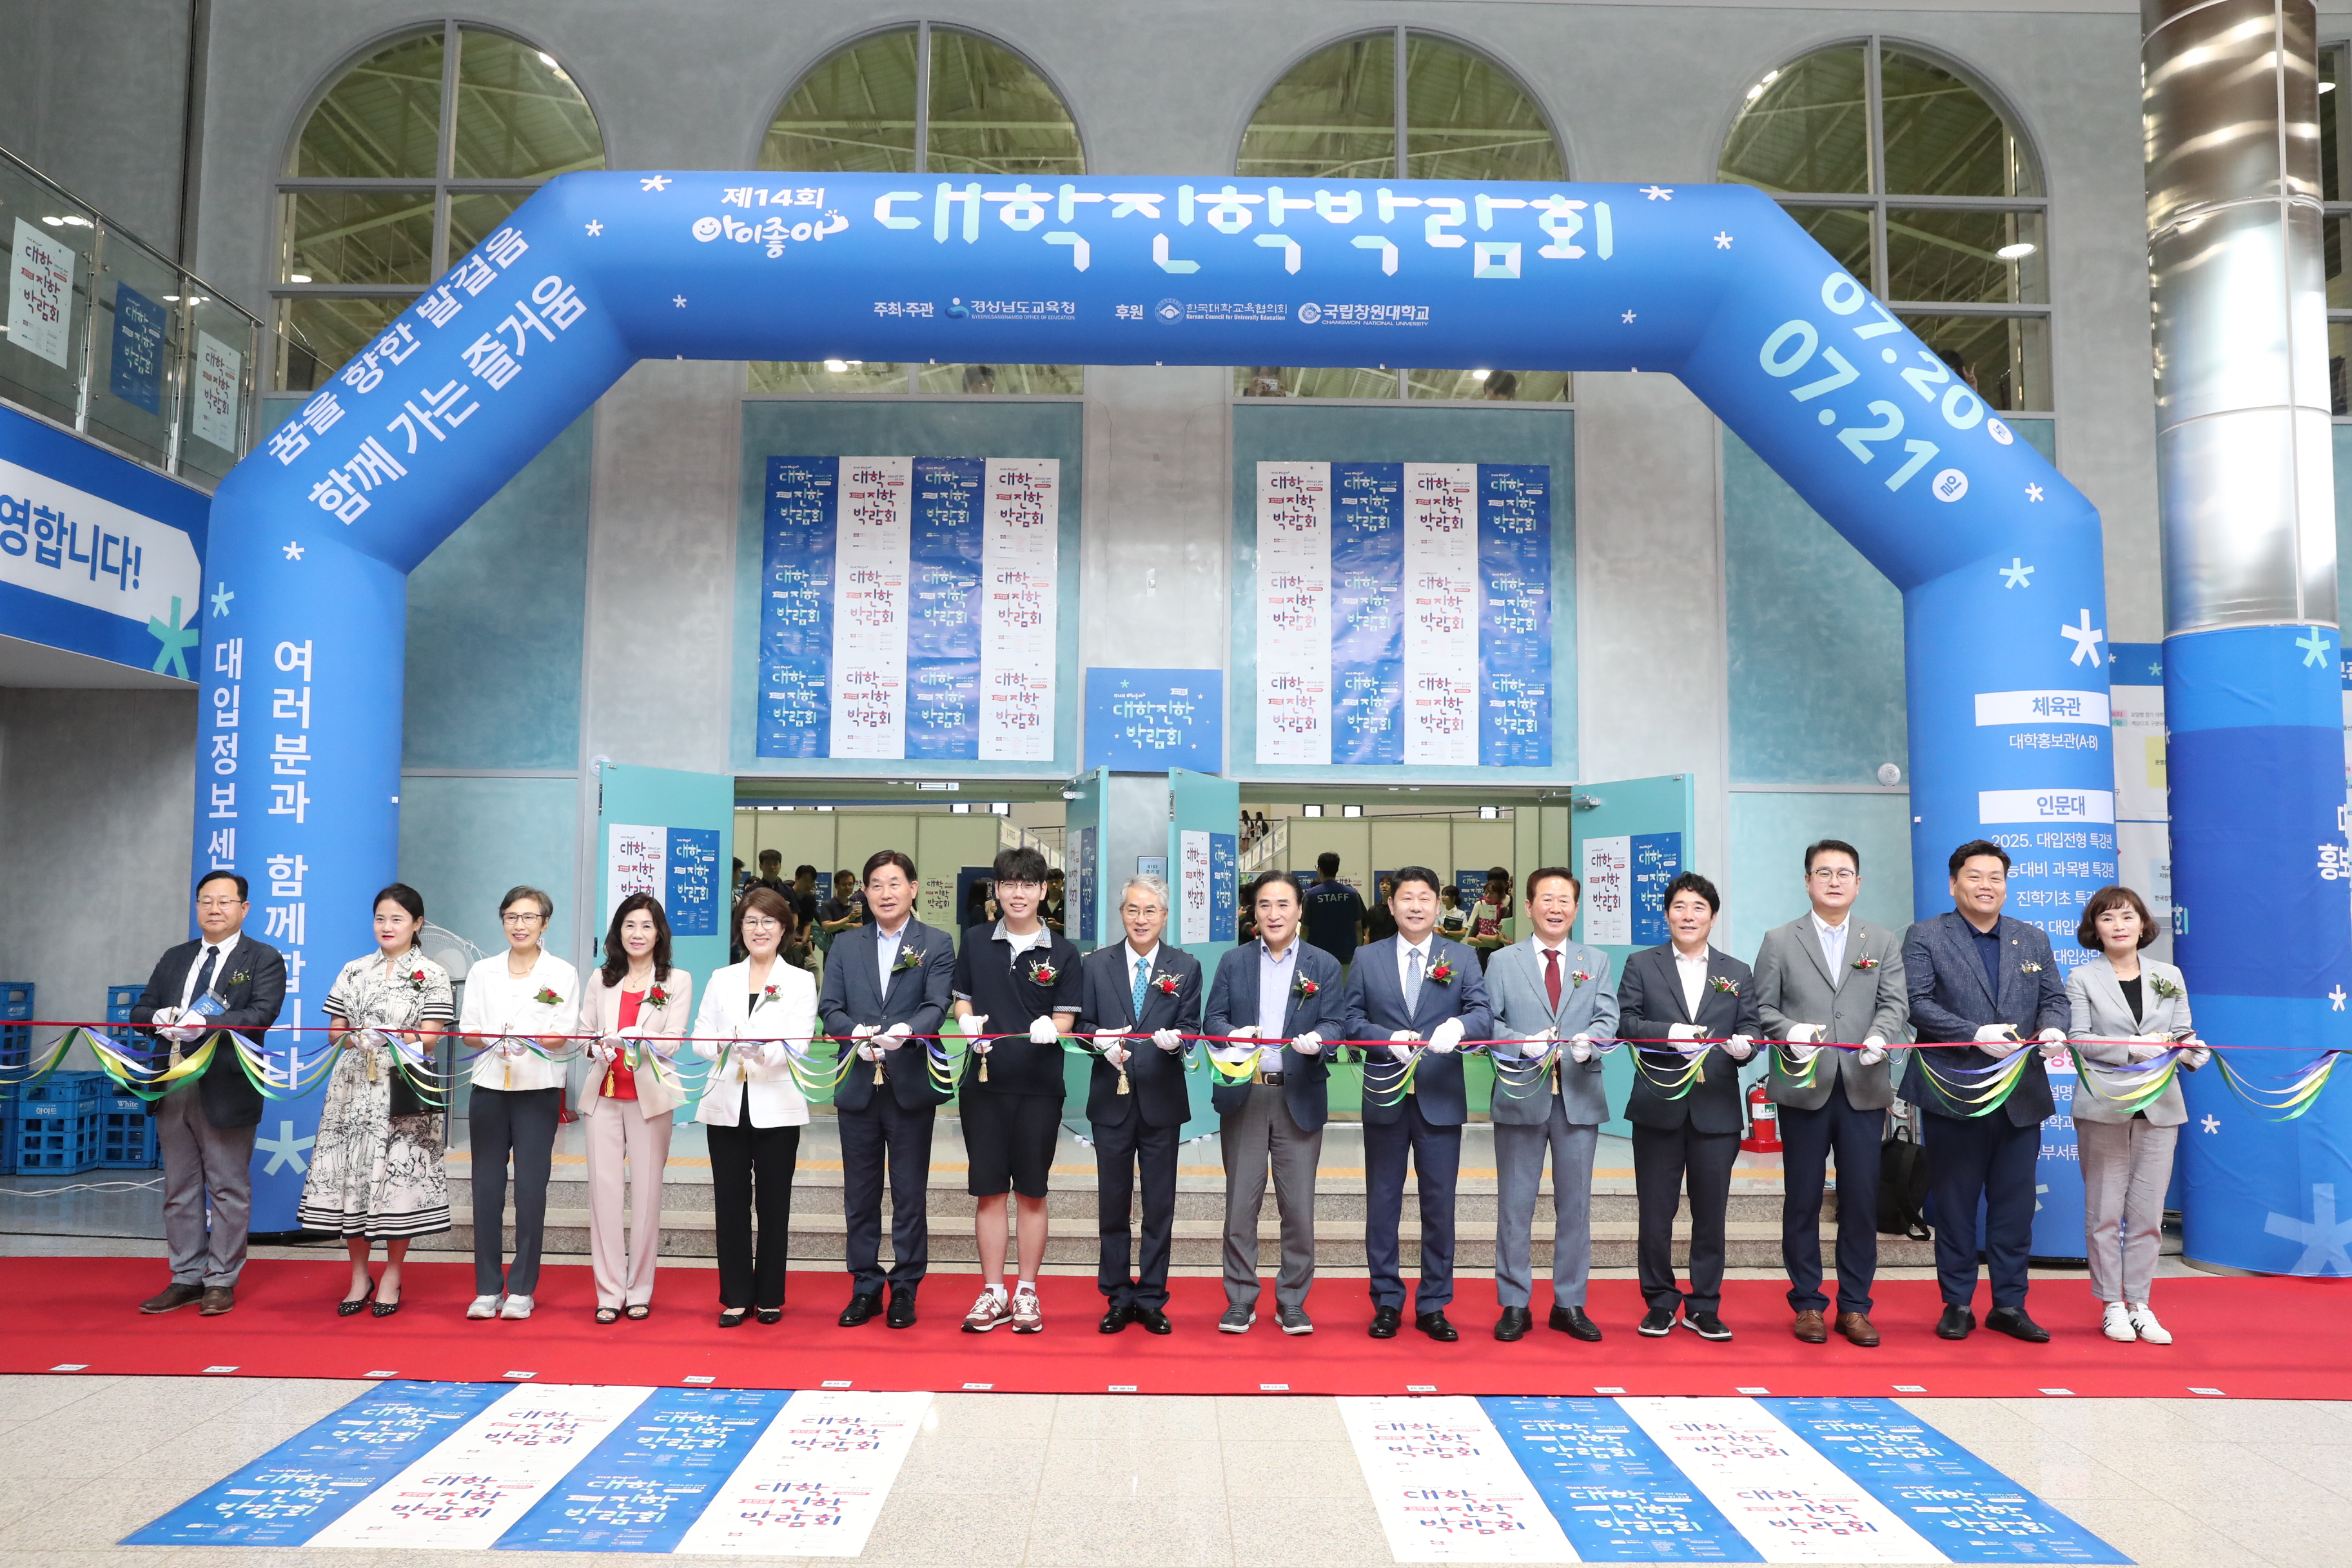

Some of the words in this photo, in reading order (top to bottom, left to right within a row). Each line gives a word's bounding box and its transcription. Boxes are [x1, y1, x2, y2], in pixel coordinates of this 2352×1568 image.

[721, 187, 825, 209] 제14회
[692, 210, 849, 258] 아이좋아
[874, 182, 1612, 279] 대학진학박람회
[25, 245, 52, 276] 대학
[36, 275, 61, 304] 진학
[24, 289, 59, 322] 박람회
[874, 302, 934, 317] 주최·주관
[971, 301, 1074, 314] 경상남도교육청
[1115, 304, 1143, 319] 후원
[1186, 302, 1288, 314] 한국대학교육협의회
[1323, 304, 1429, 320] 국립창원대학교
[126, 306, 149, 334] 대학
[135, 332, 155, 359] 진학
[268, 392, 347, 467] 꿈을
[340, 327, 422, 397] 향한
[415, 226, 531, 331] 발걸음
[1821, 271, 1984, 430] 07.20
[124, 346, 152, 376] 박람회
[206, 352, 225, 377] 대학
[213, 375, 230, 400] 진학
[204, 389, 229, 415] 박람회
[308, 437, 408, 527] 함께
[387, 380, 480, 455] 가는
[460, 274, 585, 392] 즐거움
[1759, 319, 1939, 493] 07.21
[779, 469, 813, 488] 대학
[853, 471, 885, 488] 대학
[925, 470, 959, 489] 대학
[999, 472, 1033, 489] 대학
[1271, 475, 1304, 493] 대학
[1344, 475, 1378, 495] 대학
[1418, 477, 1451, 495] 대학
[1491, 478, 1524, 496] 대학
[794, 488, 824, 507] 진학
[868, 489, 896, 507] 진학
[940, 491, 970, 508] 진학
[1014, 491, 1044, 509] 진학
[1286, 495, 1316, 512] 진학
[1360, 496, 1389, 513] 진학
[1433, 496, 1462, 513] 진학
[1506, 497, 1536, 515] 진학
[780, 505, 823, 525] 박람회
[854, 506, 896, 525] 박람회
[927, 506, 970, 526] 박람회
[1000, 508, 1043, 527] 박람회
[1273, 513, 1317, 531] 박람회
[1347, 513, 1390, 531] 박람회
[1420, 513, 1463, 532] 박람회
[1493, 514, 1536, 534] 박람회
[2033, 696, 2081, 716] 체육관
[268, 638, 313, 825] 여러분과
[1126, 723, 1182, 749] 박람회
[2010, 733, 2099, 750] 대학홍보관(A·B)
[207, 637, 244, 871] 대입정보센
[2037, 796, 2085, 816] 인문대
[1991, 835, 2032, 848] 2025.
[2037, 832, 2086, 848] 대입전형
[2090, 833, 2112, 849] 특강관
[620, 841, 646, 861] 대학
[676, 843, 701, 863] 대학
[1187, 847, 1200, 867] 대학
[1591, 853, 1612, 871] 대학
[2008, 862, 2048, 878] 능대비
[2053, 861, 2089, 877] 과목별
[2092, 862, 2114, 877] 특강관
[2317, 843, 2350, 881] 홍보
[632, 861, 654, 882] 진학
[687, 864, 709, 884] 진학
[1193, 868, 1204, 888] 진학
[927, 880, 945, 890] 대학
[1601, 872, 1620, 892] 진학
[678, 882, 709, 903] 박람회
[934, 890, 949, 899] 진학
[1188, 890, 1204, 908] 박람회
[1317, 893, 1349, 903] STAFF
[1593, 891, 1620, 912] 박람회
[2017, 890, 2072, 906] 진학기초
[928, 899, 950, 910] 박람회
[2049, 920, 2079, 936] 대입
[2051, 1084, 2075, 1101] 설명
[2037, 1144, 2079, 1161] 부서류
[255, 1472, 333, 1487] 대학
[421, 1475, 498, 1489] 대학
[586, 1479, 664, 1494] 대학
[268, 1487, 338, 1504] 진학
[440, 1490, 507, 1505] 진학
[754, 1483, 829, 1496] 대학
[1404, 1489, 1477, 1504] 대학
[1569, 1489, 1646, 1504] 대학
[1901, 1489, 1983, 1504] 대학
[215, 1500, 319, 1518] 박람회
[609, 1494, 678, 1510] 진학
[781, 1496, 848, 1513] 진학
[390, 1503, 492, 1520] 박람회
[564, 1507, 667, 1525] 박람회
[740, 1511, 841, 1527] 박람회
[1444, 1504, 1512, 1519] 진학
[1614, 1503, 1687, 1520] 진학
[1954, 1505, 2032, 1520] 진학
[1420, 1518, 1525, 1534] 박람회
[1594, 1516, 1703, 1535] 박람회
[1942, 1519, 2055, 1535] 박람회
